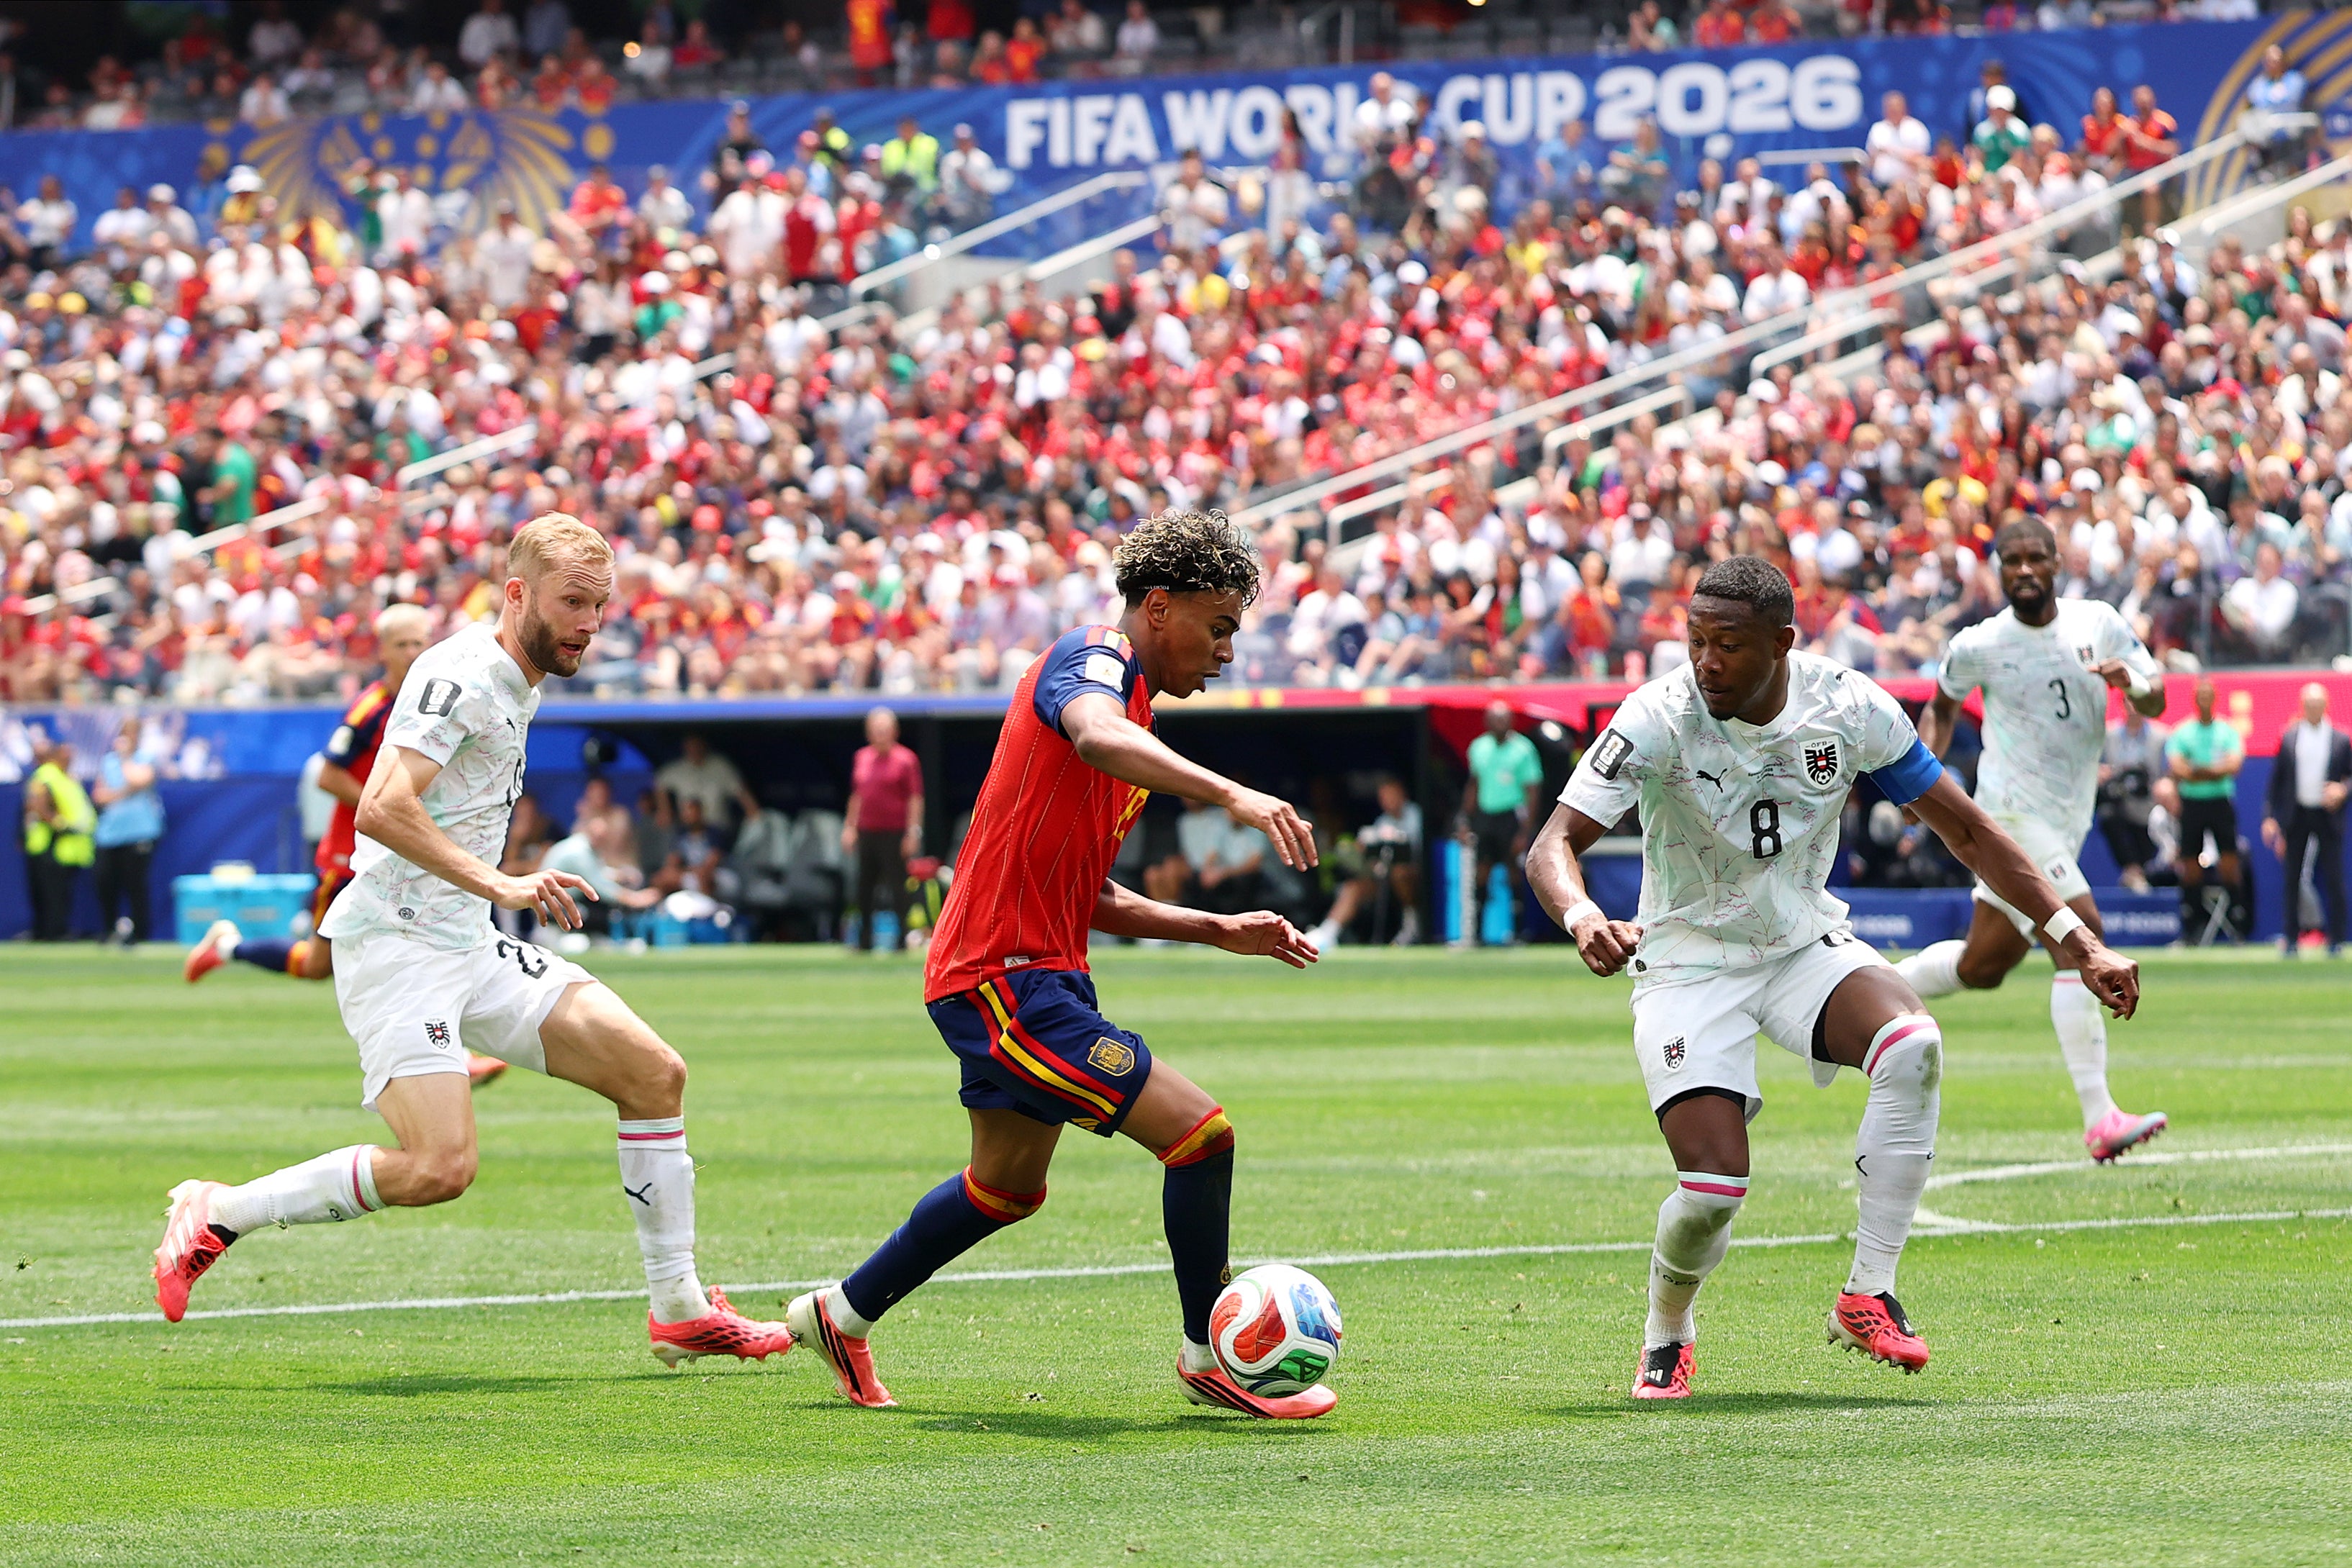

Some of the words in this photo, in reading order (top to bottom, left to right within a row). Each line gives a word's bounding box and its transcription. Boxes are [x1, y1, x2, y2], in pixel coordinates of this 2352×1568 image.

[1008, 94, 1158, 168] FIFA
[1163, 79, 1420, 159] WORL
[1439, 71, 1586, 145] CUP
[1593, 55, 1864, 140] 2026
[2048, 679, 2070, 720] 3
[1750, 799, 1782, 859] 8
[497, 933, 549, 979] 2
